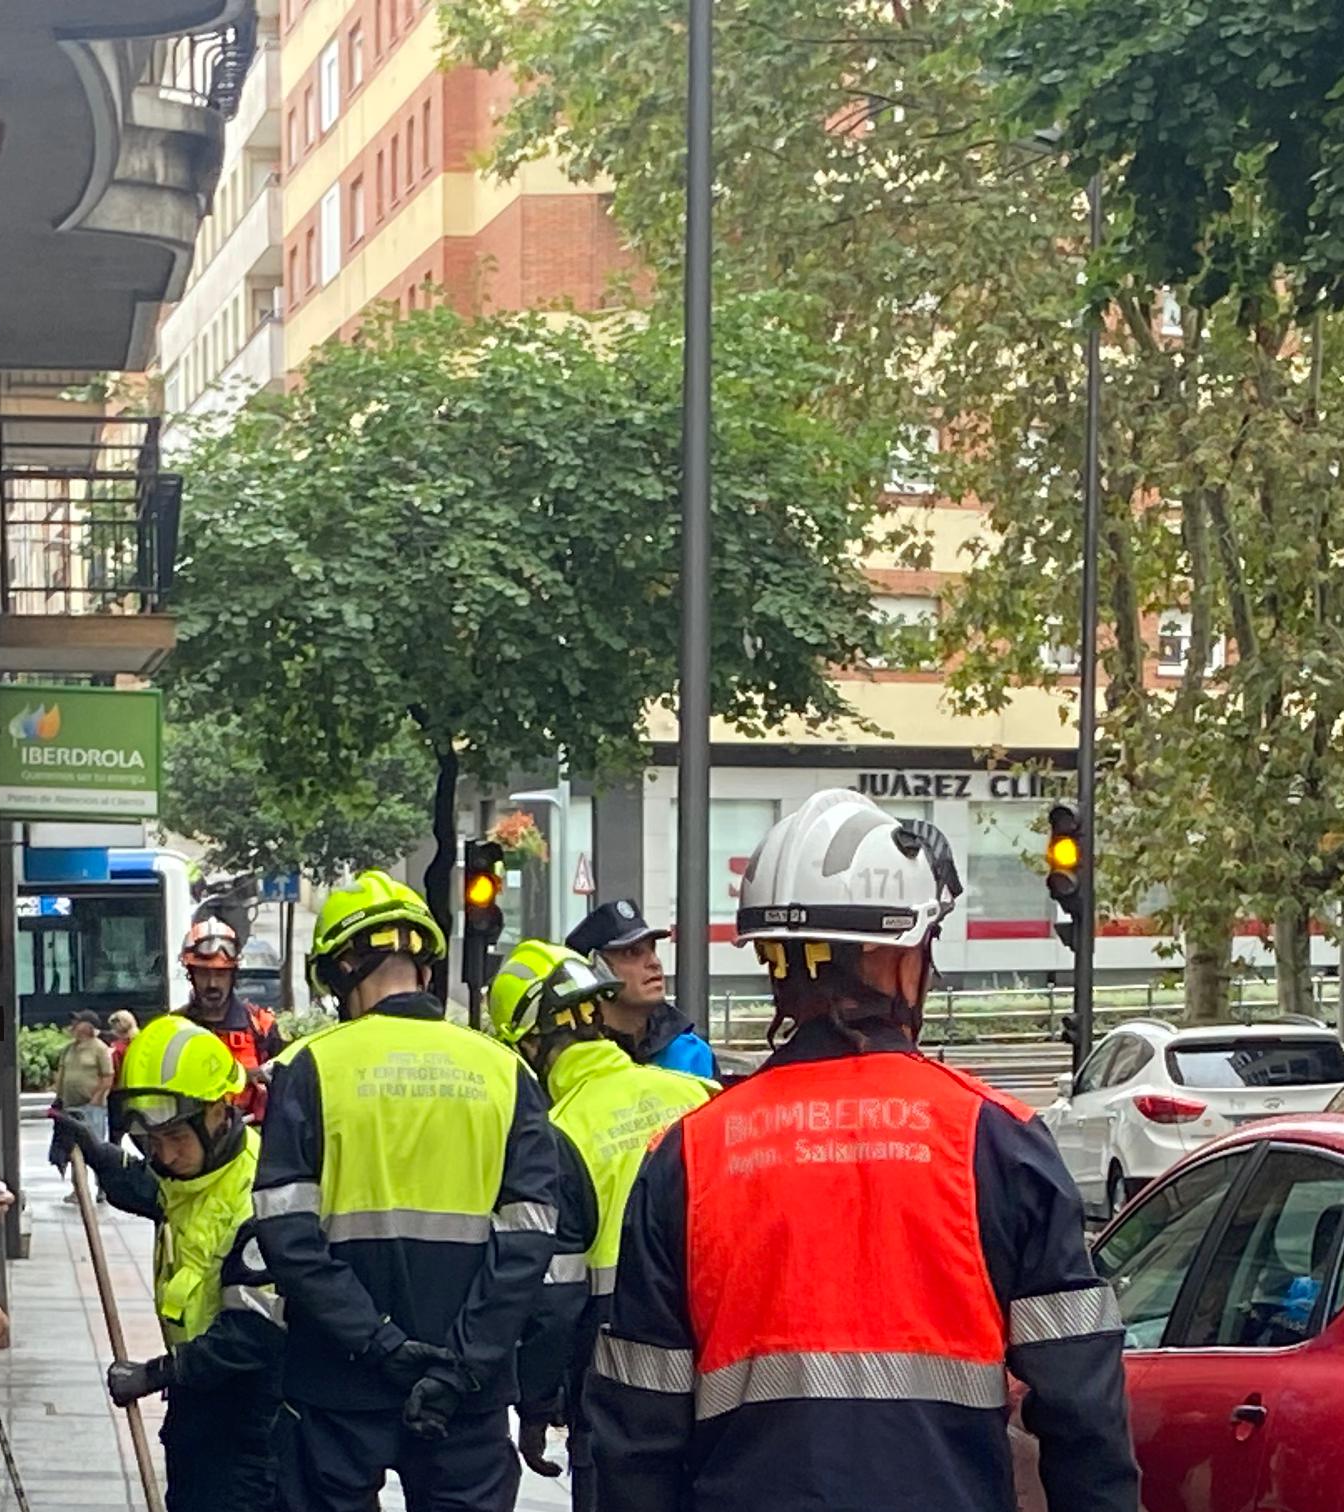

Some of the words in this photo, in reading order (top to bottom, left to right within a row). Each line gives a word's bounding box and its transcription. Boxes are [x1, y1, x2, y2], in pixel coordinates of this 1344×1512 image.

[21, 746, 146, 769] IBERDROLA
[858, 868, 905, 899] 171
[373, 1066, 486, 1085] EMERGENCIAS
[725, 1097, 932, 1147] BOMBEROS
[795, 1139, 932, 1164] Salamanca
